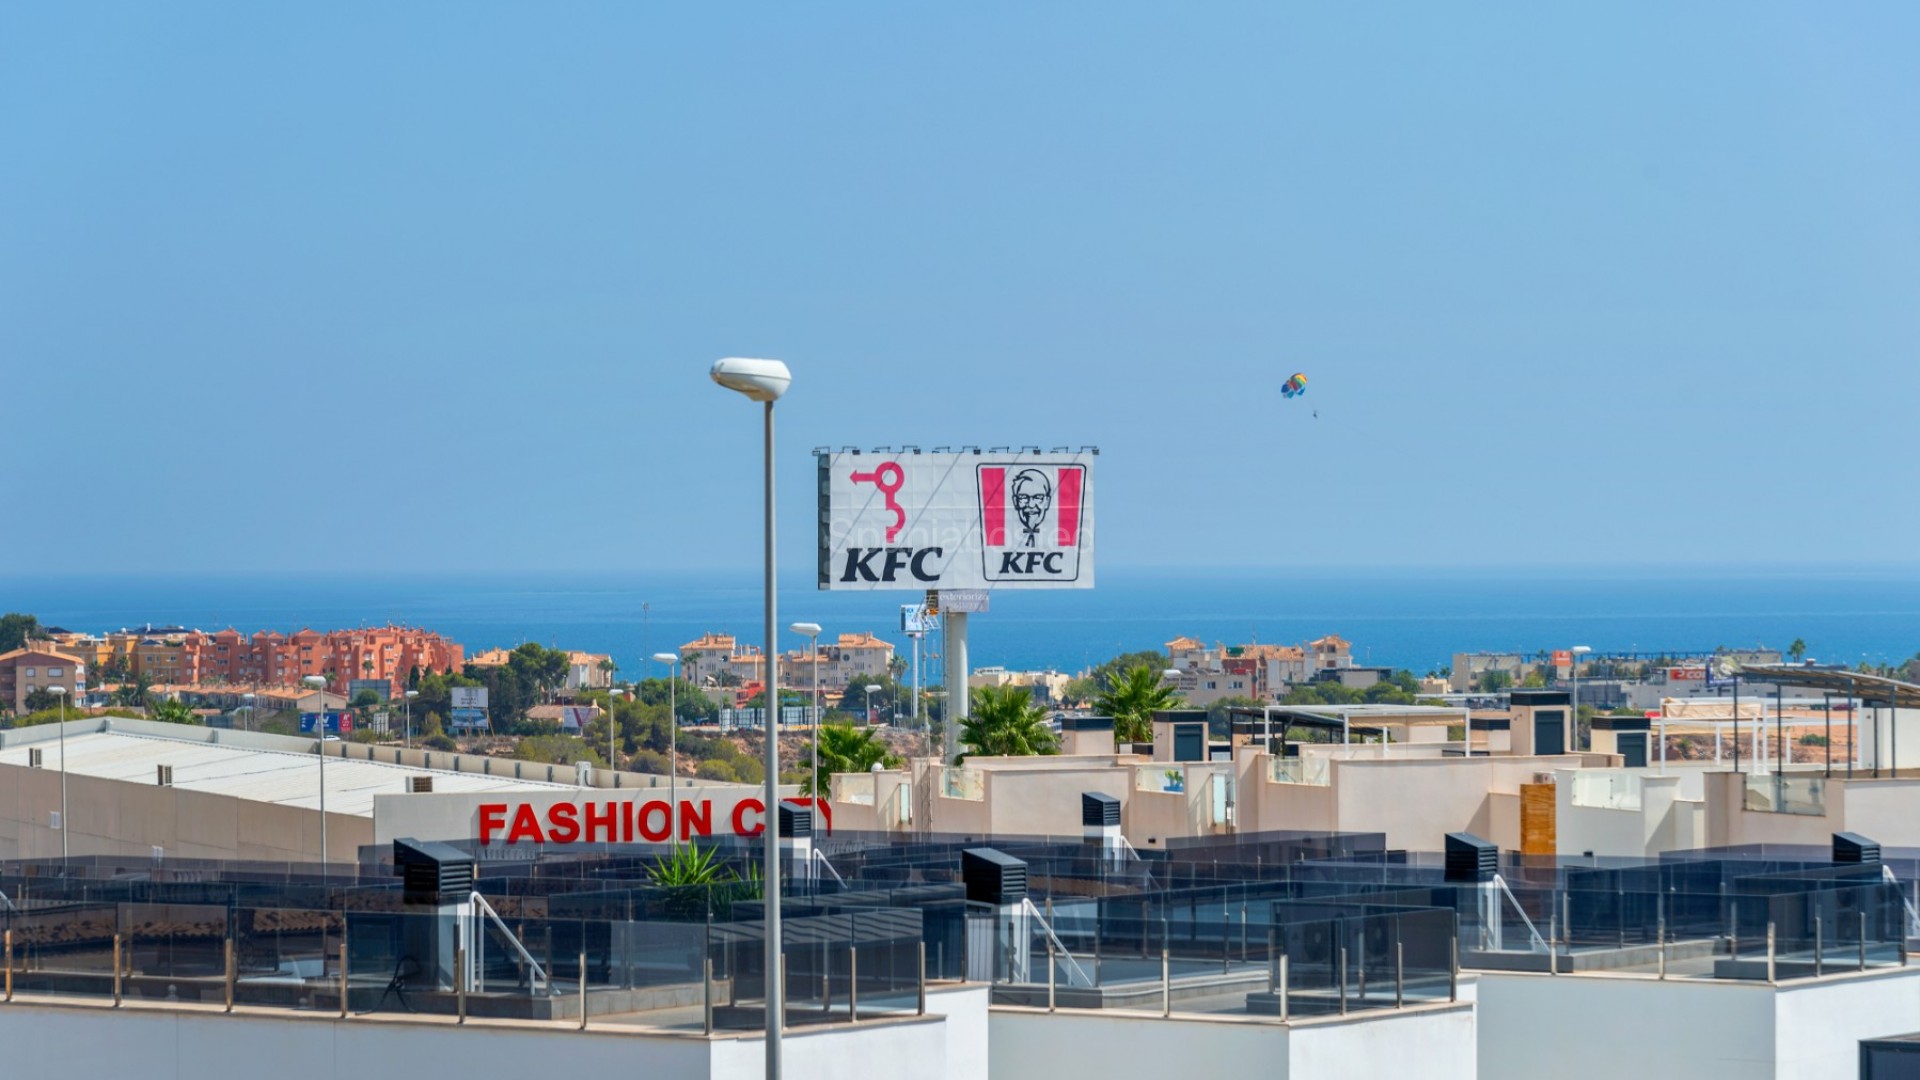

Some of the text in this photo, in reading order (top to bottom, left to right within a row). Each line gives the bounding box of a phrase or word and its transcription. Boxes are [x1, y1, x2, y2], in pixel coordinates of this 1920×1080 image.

[840, 547, 943, 582] KFC
[999, 551, 1064, 574] KFC
[479, 800, 712, 845] FASHION
